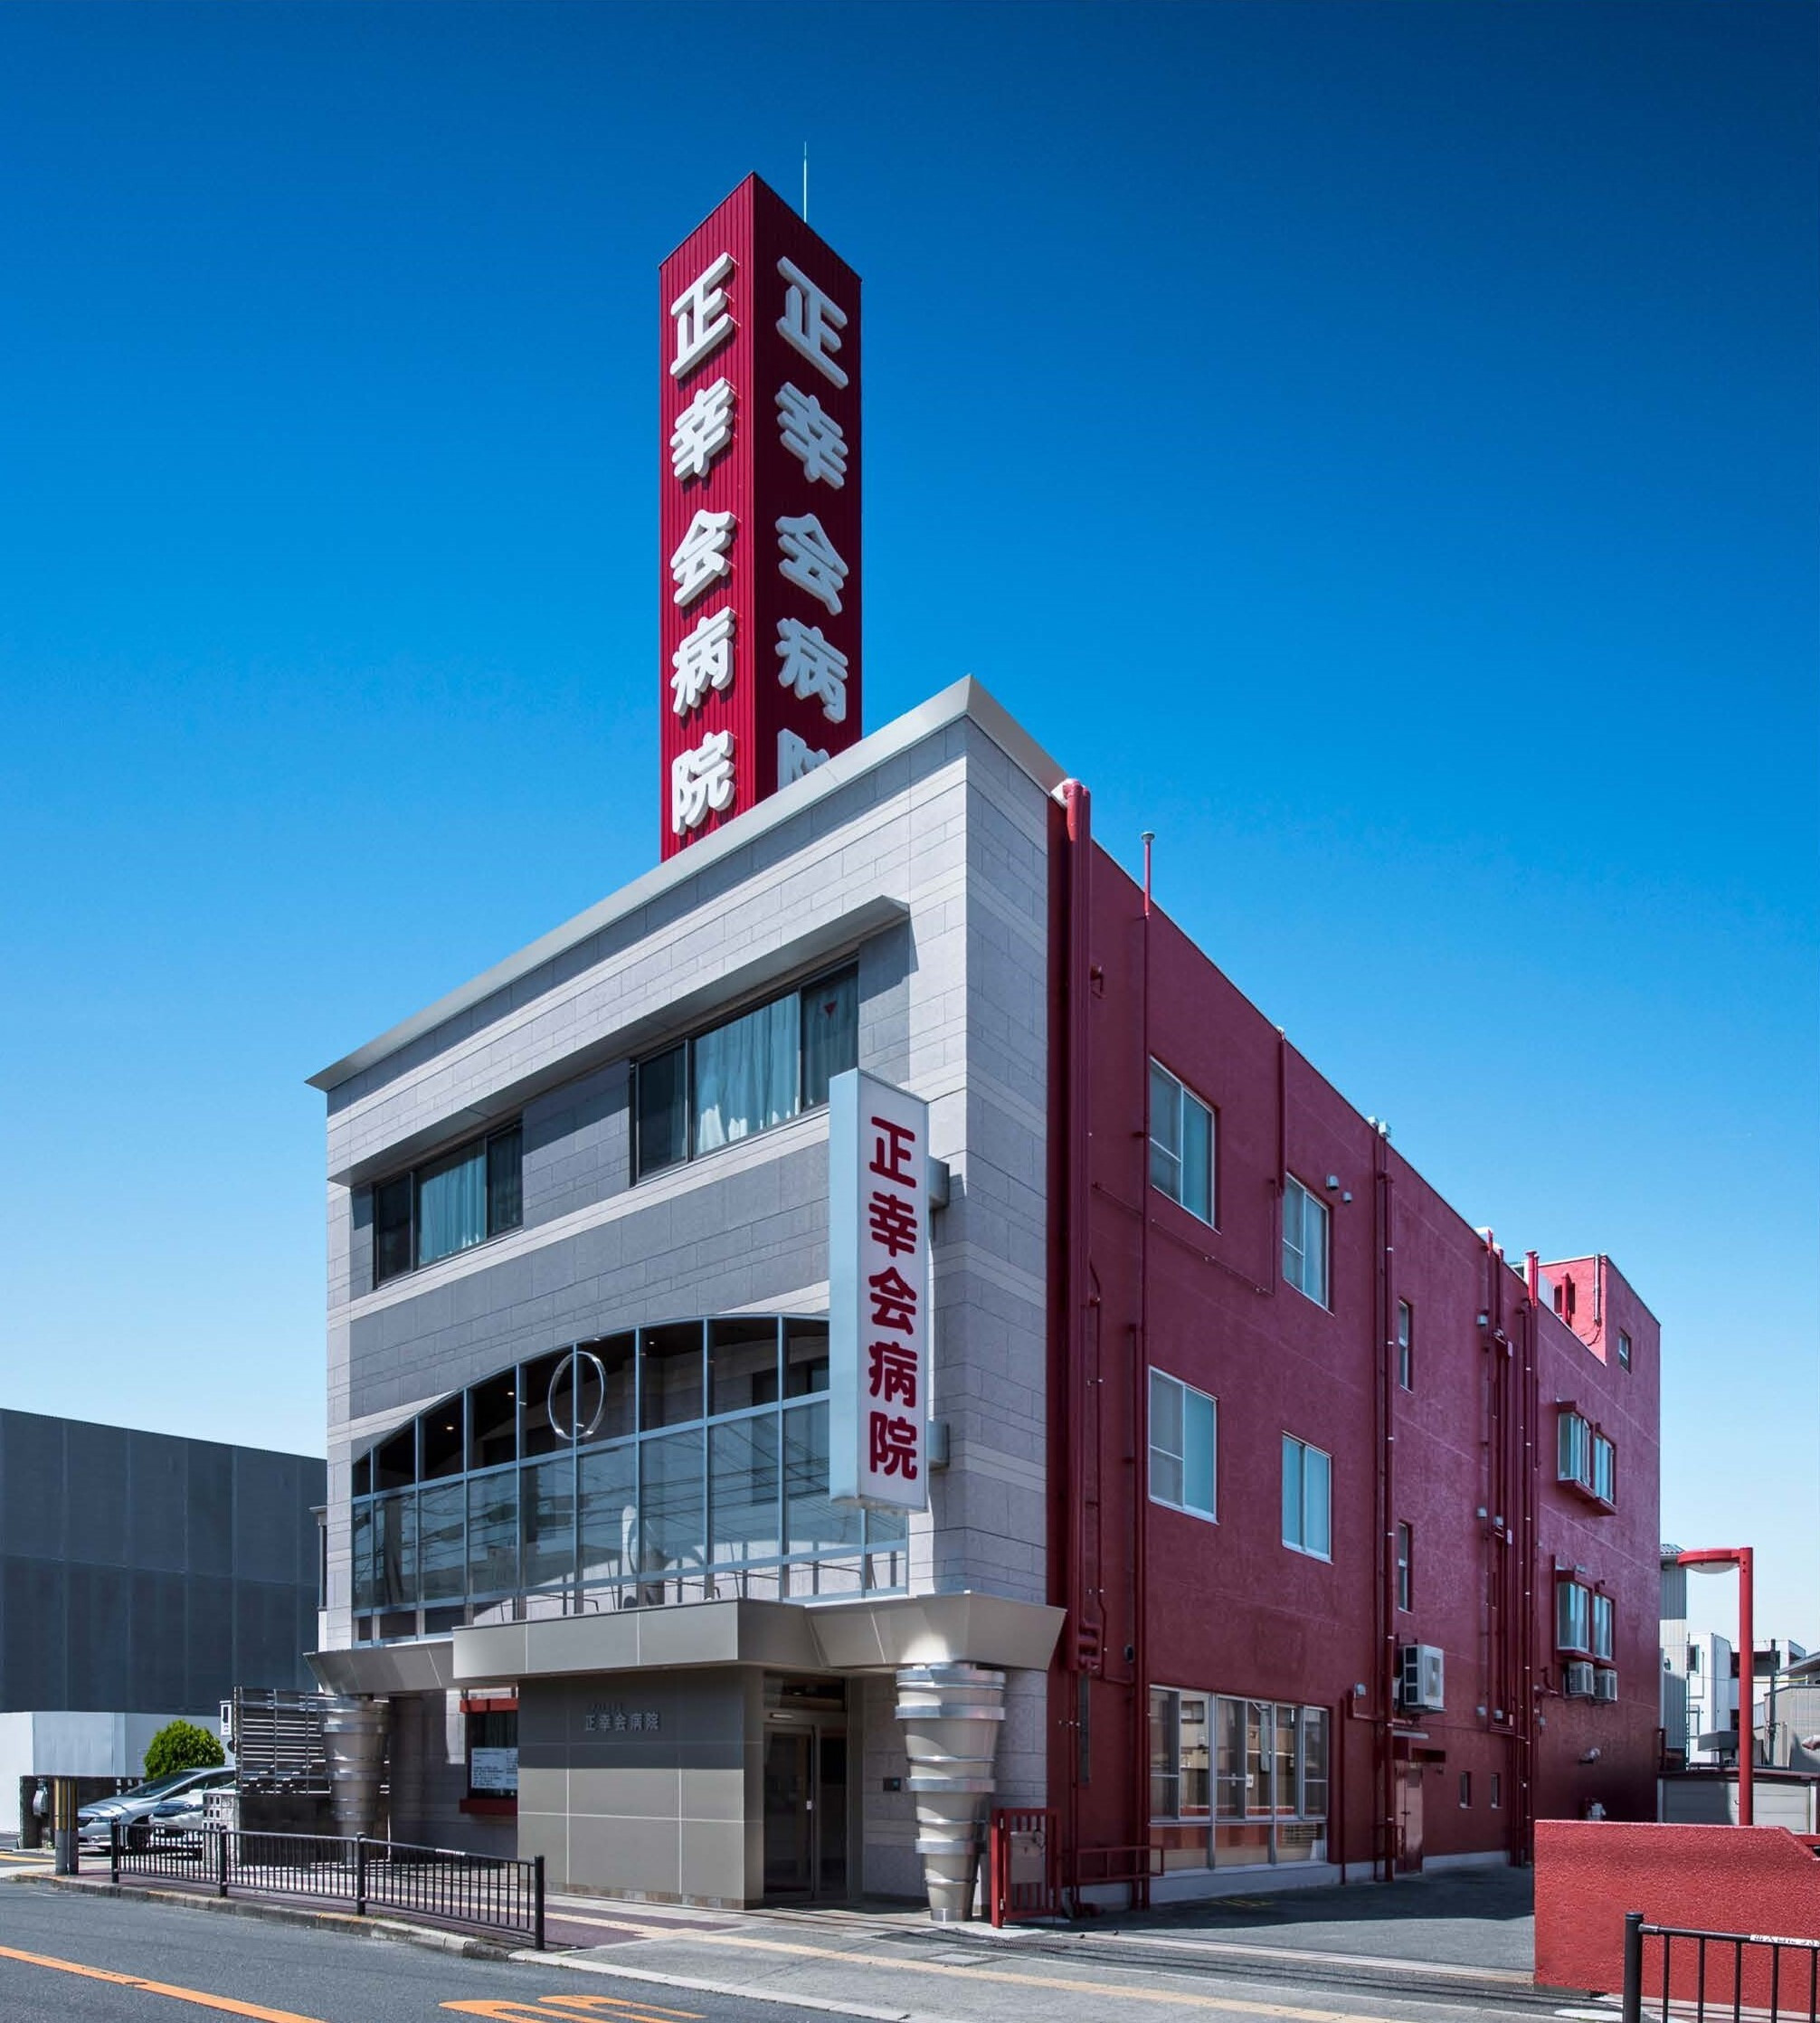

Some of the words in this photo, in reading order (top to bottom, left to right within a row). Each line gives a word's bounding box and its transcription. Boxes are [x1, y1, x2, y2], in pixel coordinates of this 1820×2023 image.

[670, 252, 736, 836] 正幸会病院
[868, 1116, 918, 1481] 正幸会病院
[585, 1711, 659, 1732] 正幸会病院
